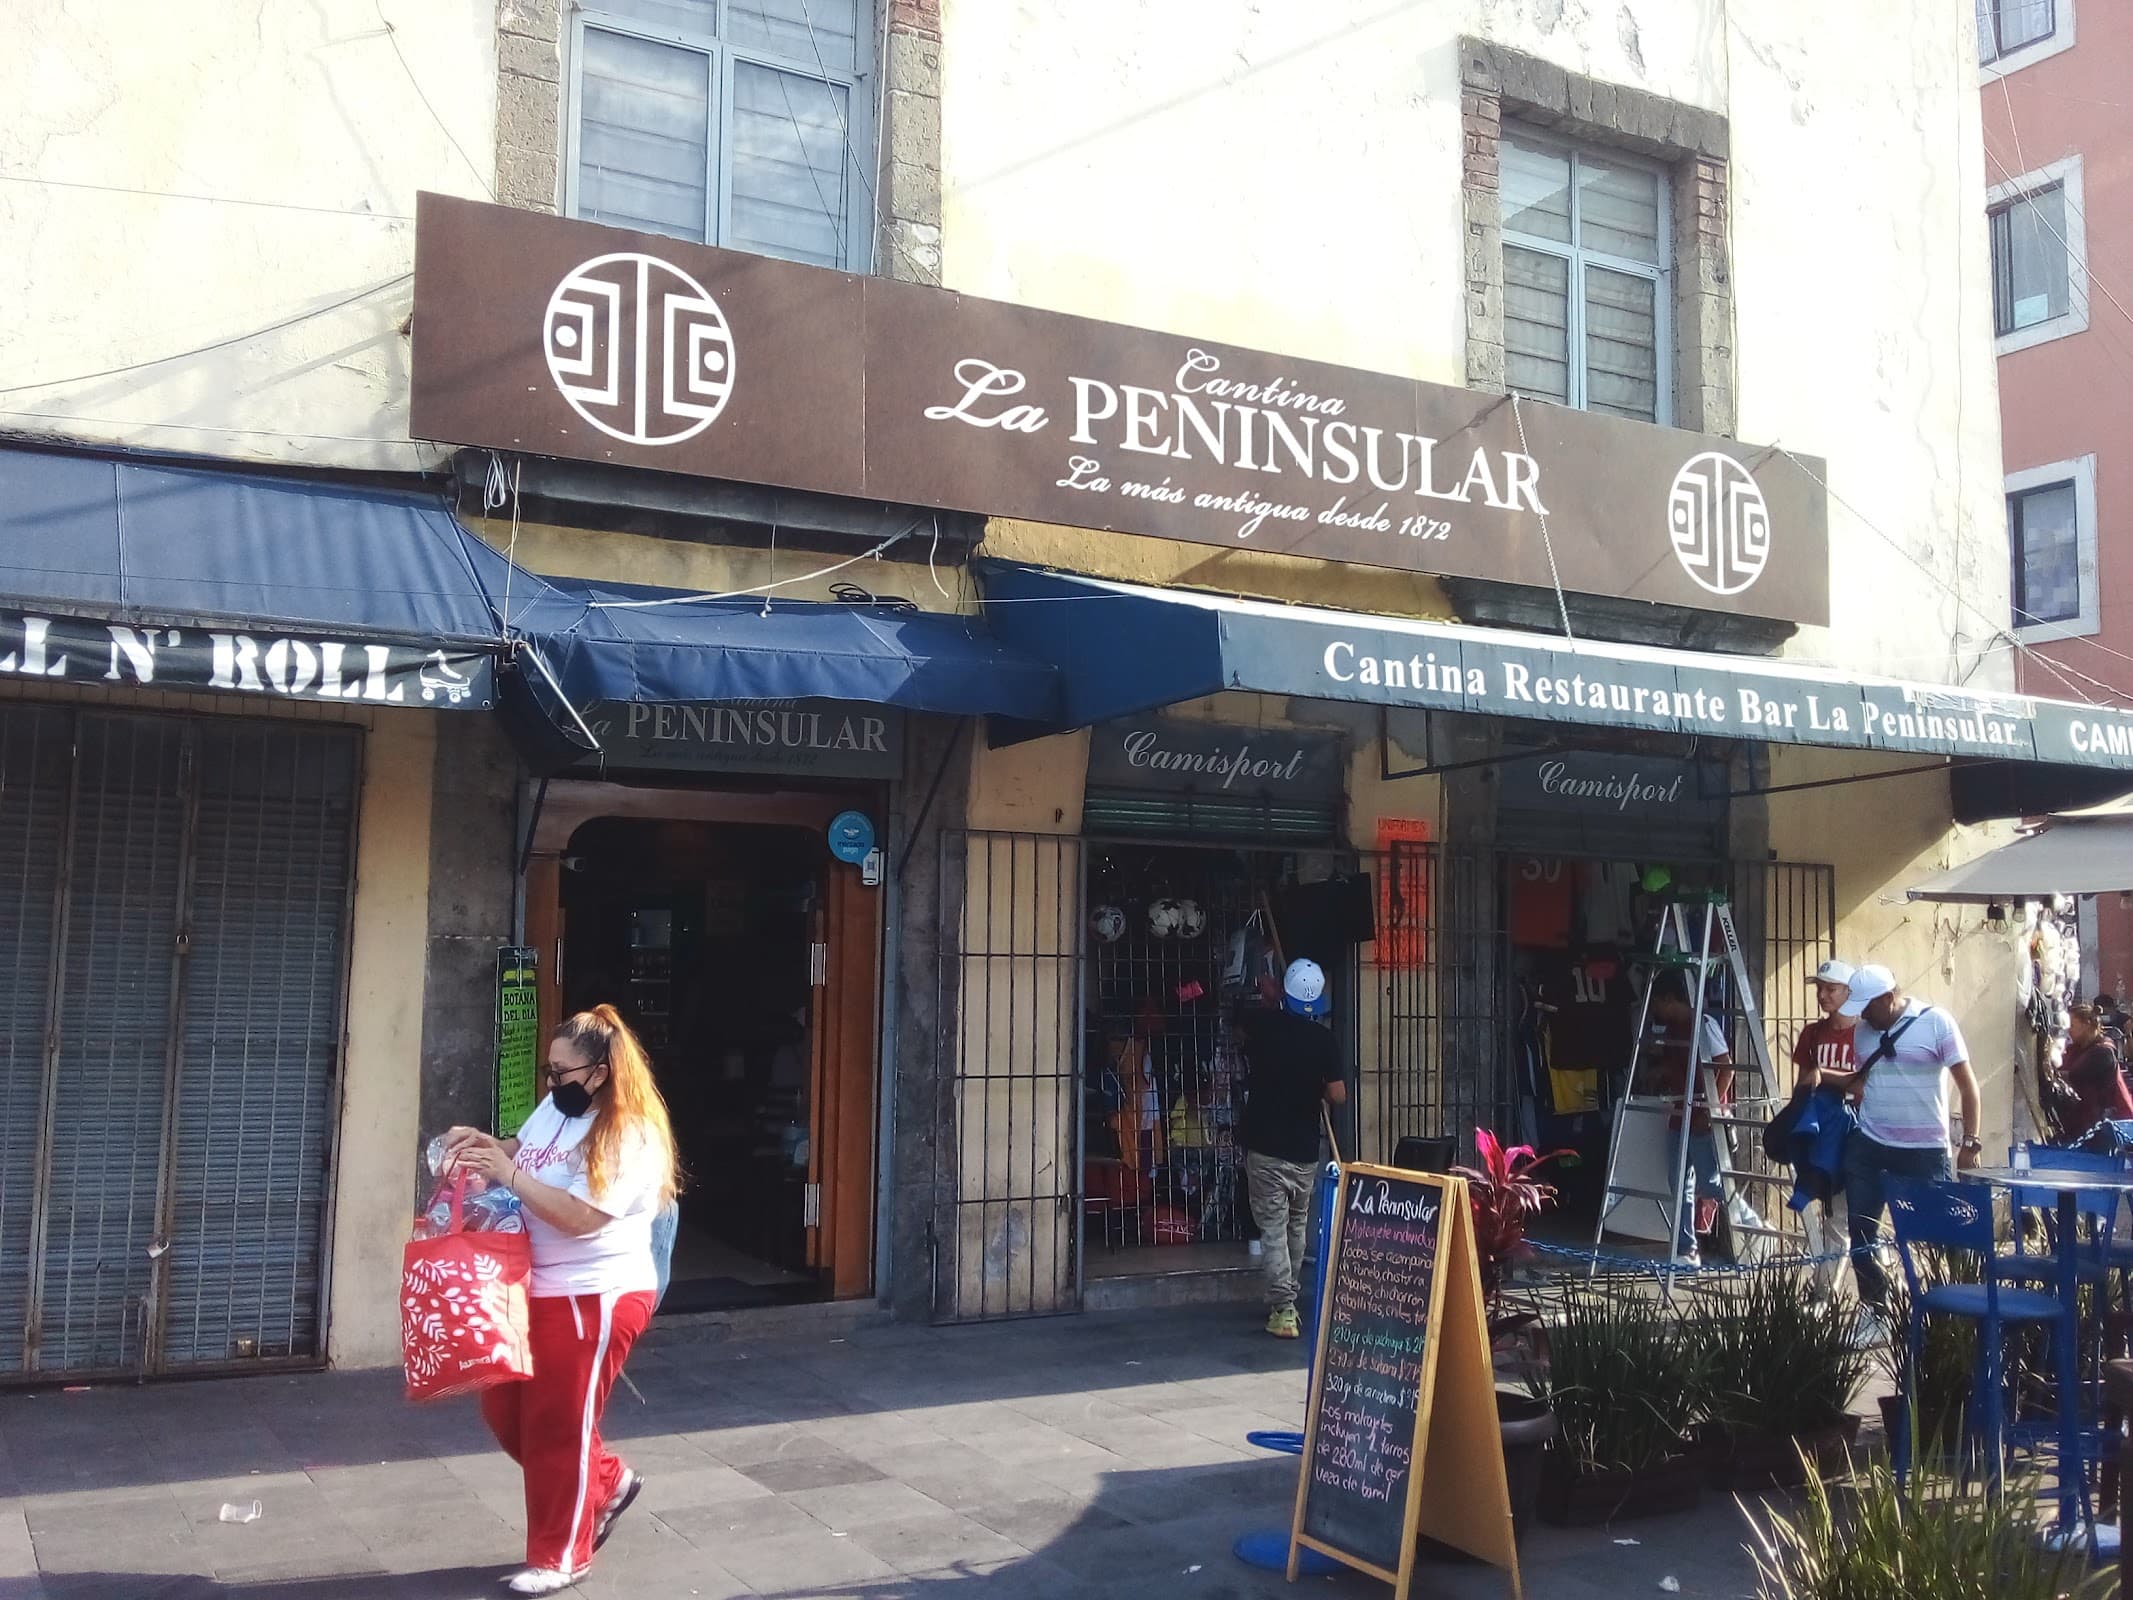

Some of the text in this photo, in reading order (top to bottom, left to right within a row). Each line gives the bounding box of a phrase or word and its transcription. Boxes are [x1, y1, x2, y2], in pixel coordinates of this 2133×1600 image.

[1175, 348, 1346, 416] Cantina
[924, 358, 1550, 516] La PENINSULAR
[1056, 455, 1452, 541] La más antigua desde 1872
[0, 616, 67, 676] L
[209, 633, 405, 702] ROLL
[1323, 641, 2017, 746] Cantina Restaurante Bar La Peninsular
[625, 702, 888, 752] PENINSULAR
[1124, 731, 1304, 789] Camisport
[1539, 761, 1683, 811] Camisport
[1722, 917, 1737, 952] KELLER
[503, 992, 535, 1007] BOTANA
[504, 1010, 520, 1023] DEL
[1321, 1397, 1341, 1421] Los
